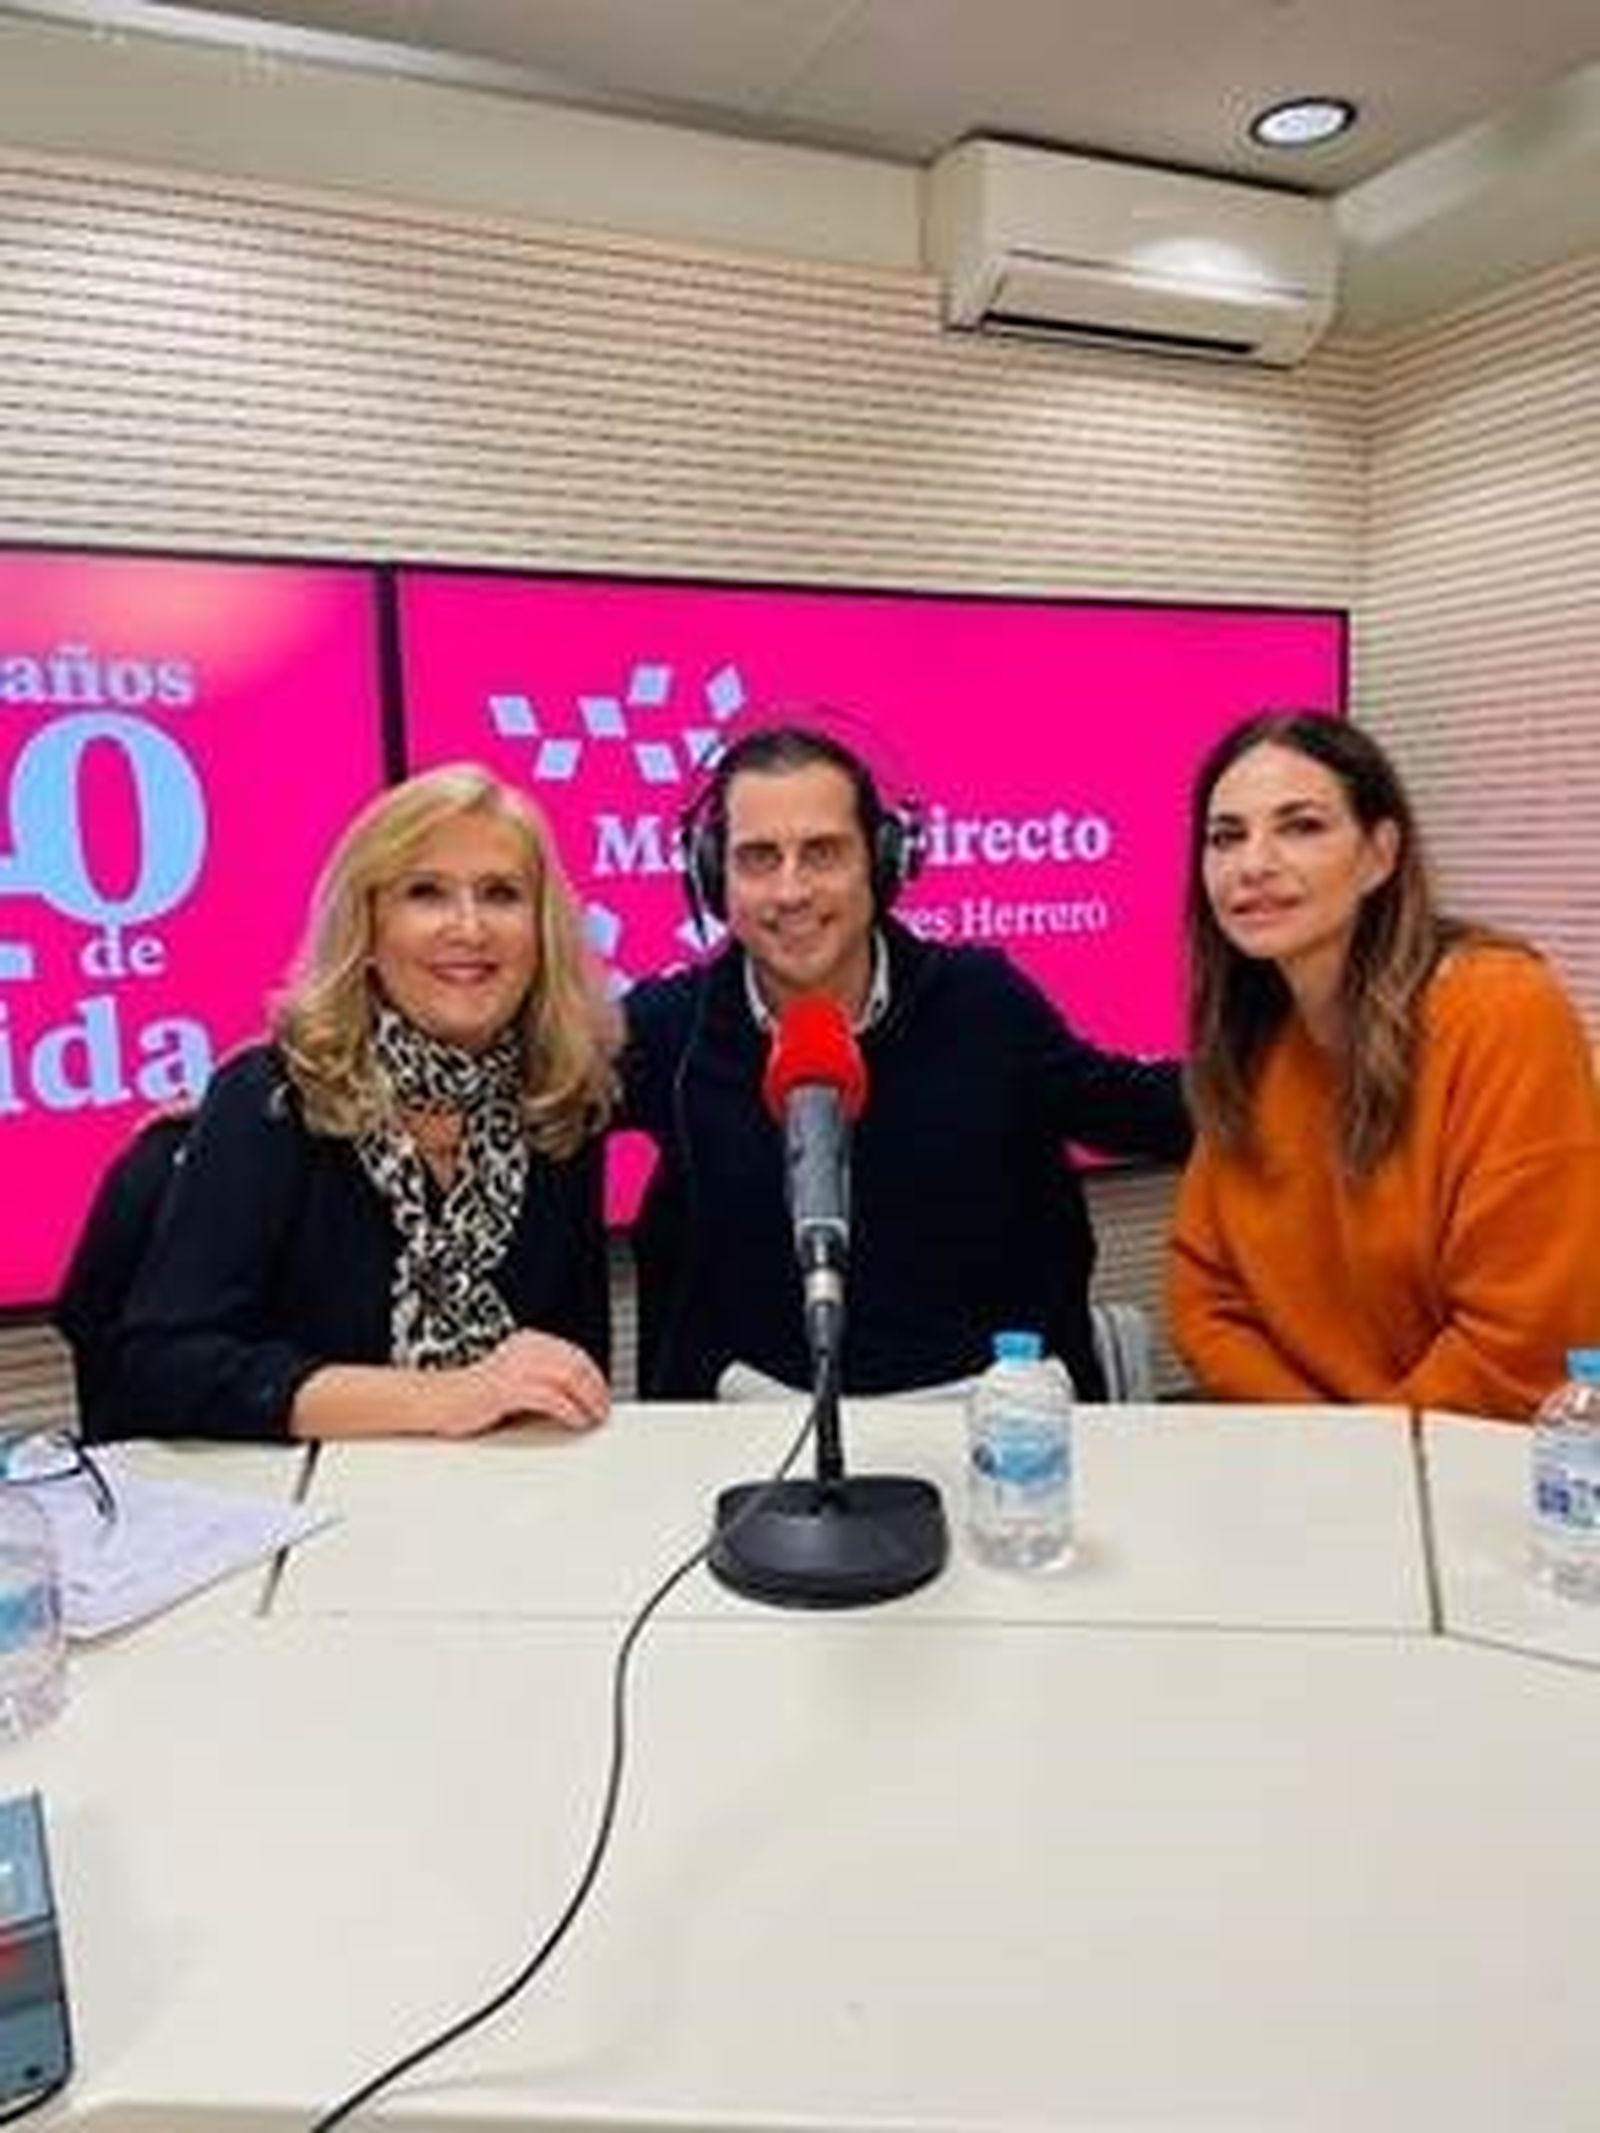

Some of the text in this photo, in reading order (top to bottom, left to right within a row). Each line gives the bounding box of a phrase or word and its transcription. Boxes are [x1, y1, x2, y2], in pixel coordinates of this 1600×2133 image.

[0, 646, 194, 704] años
[0, 711, 208, 976] 0
[915, 804, 1110, 865] irecto
[80, 922, 166, 977] de
[0, 995, 210, 1111] ida
